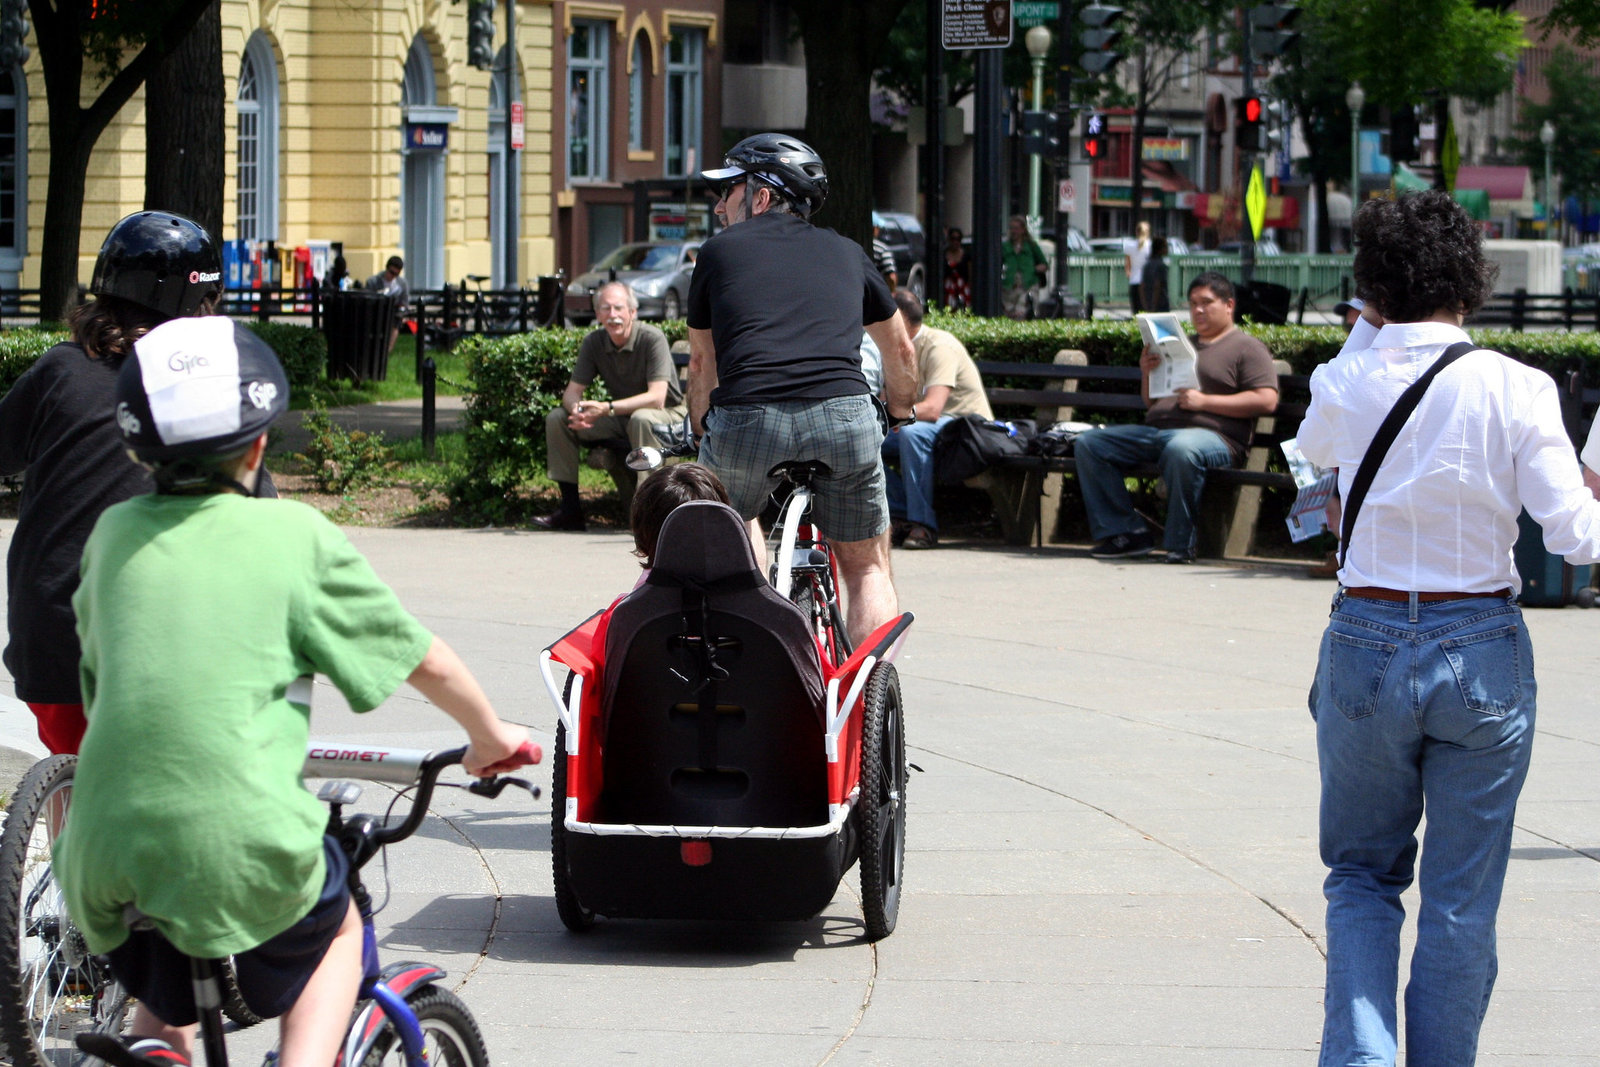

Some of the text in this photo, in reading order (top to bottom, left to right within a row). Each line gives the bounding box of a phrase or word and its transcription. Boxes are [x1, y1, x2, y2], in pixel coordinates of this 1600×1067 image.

[945, 4, 962, 12] Park
[1013, 5, 1045, 17] UPONT
[199, 271, 221, 282] Razor
[168, 350, 209, 374] Giro
[309, 748, 390, 762] COMET
